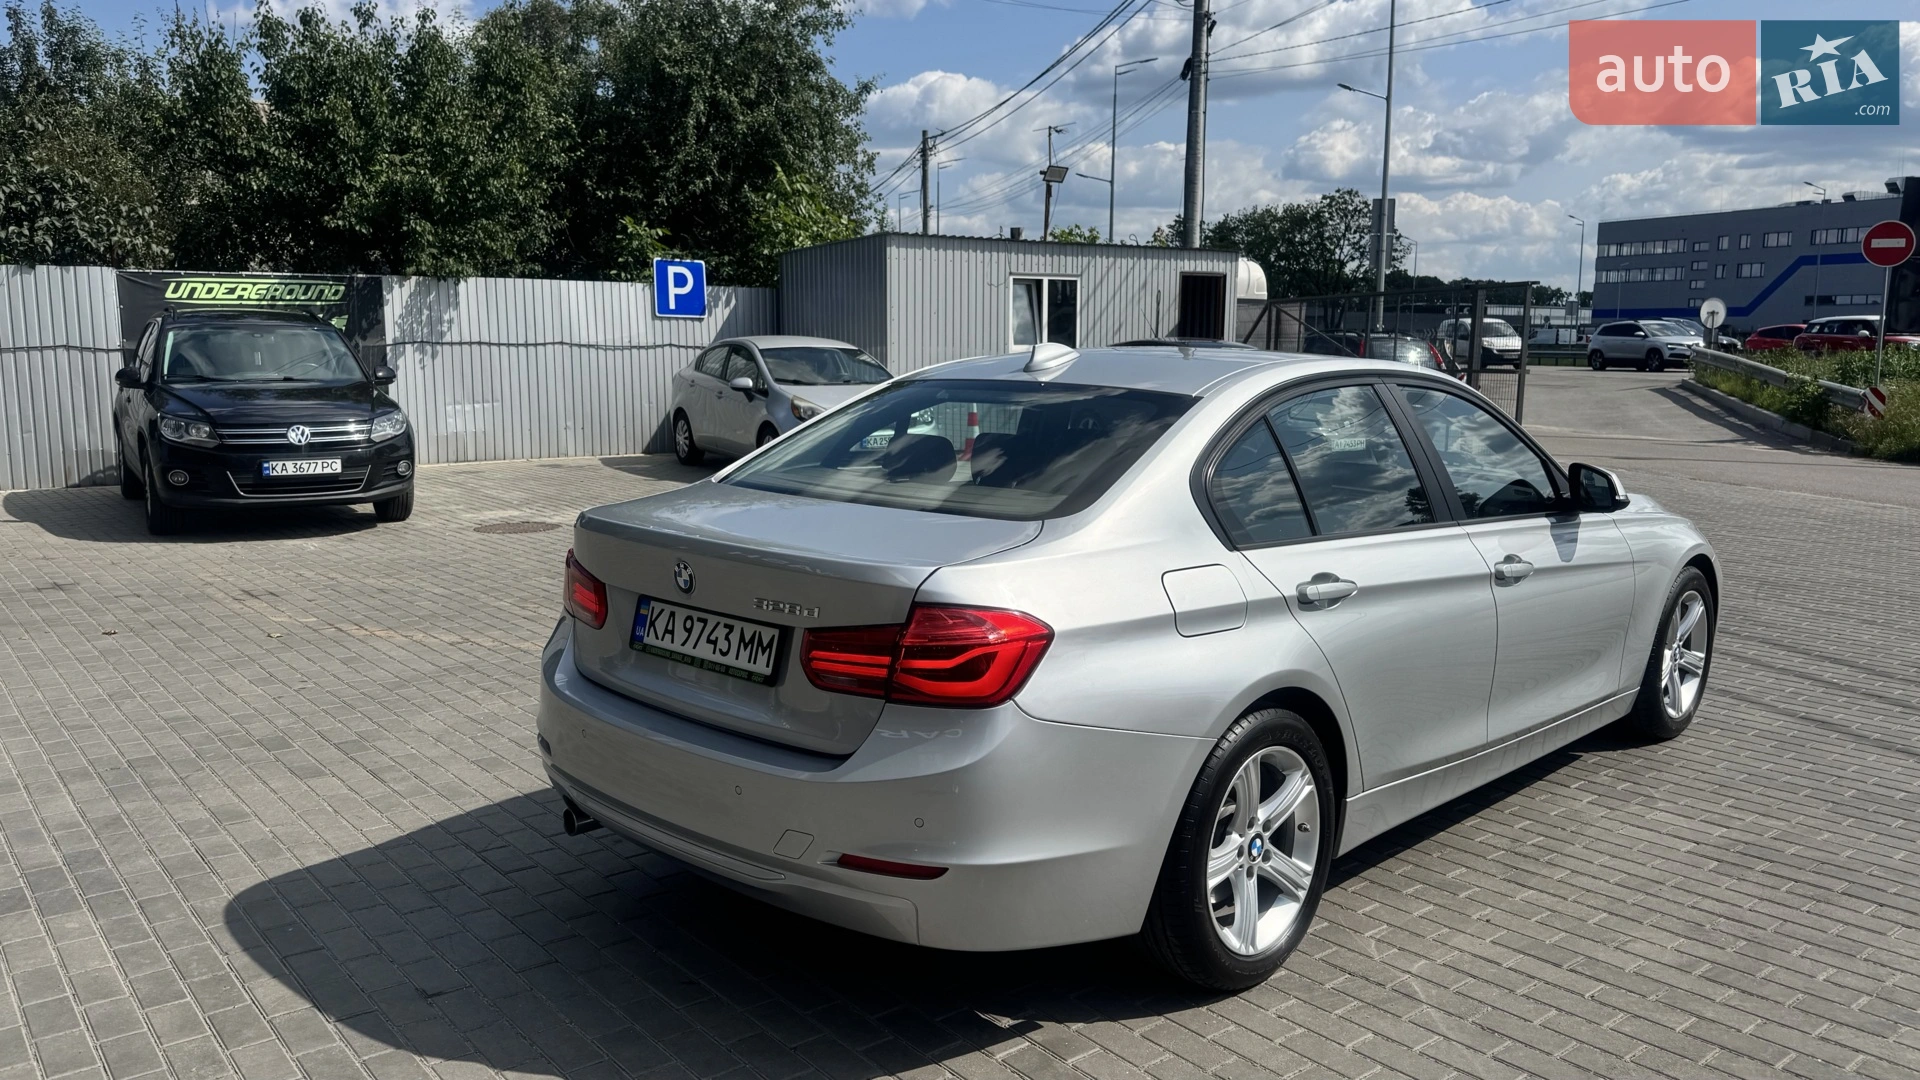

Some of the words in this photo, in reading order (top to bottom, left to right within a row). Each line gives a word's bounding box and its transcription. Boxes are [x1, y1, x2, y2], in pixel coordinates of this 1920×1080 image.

[164, 282, 346, 300] UNDERGROUND
[667, 265, 694, 310] P
[271, 463, 289, 474] KA
[291, 462, 319, 474] 3677
[321, 461, 338, 472] PC
[753, 597, 820, 618] 328d
[646, 606, 676, 644] KA
[680, 615, 735, 657] 9743
[736, 626, 775, 668] MM
